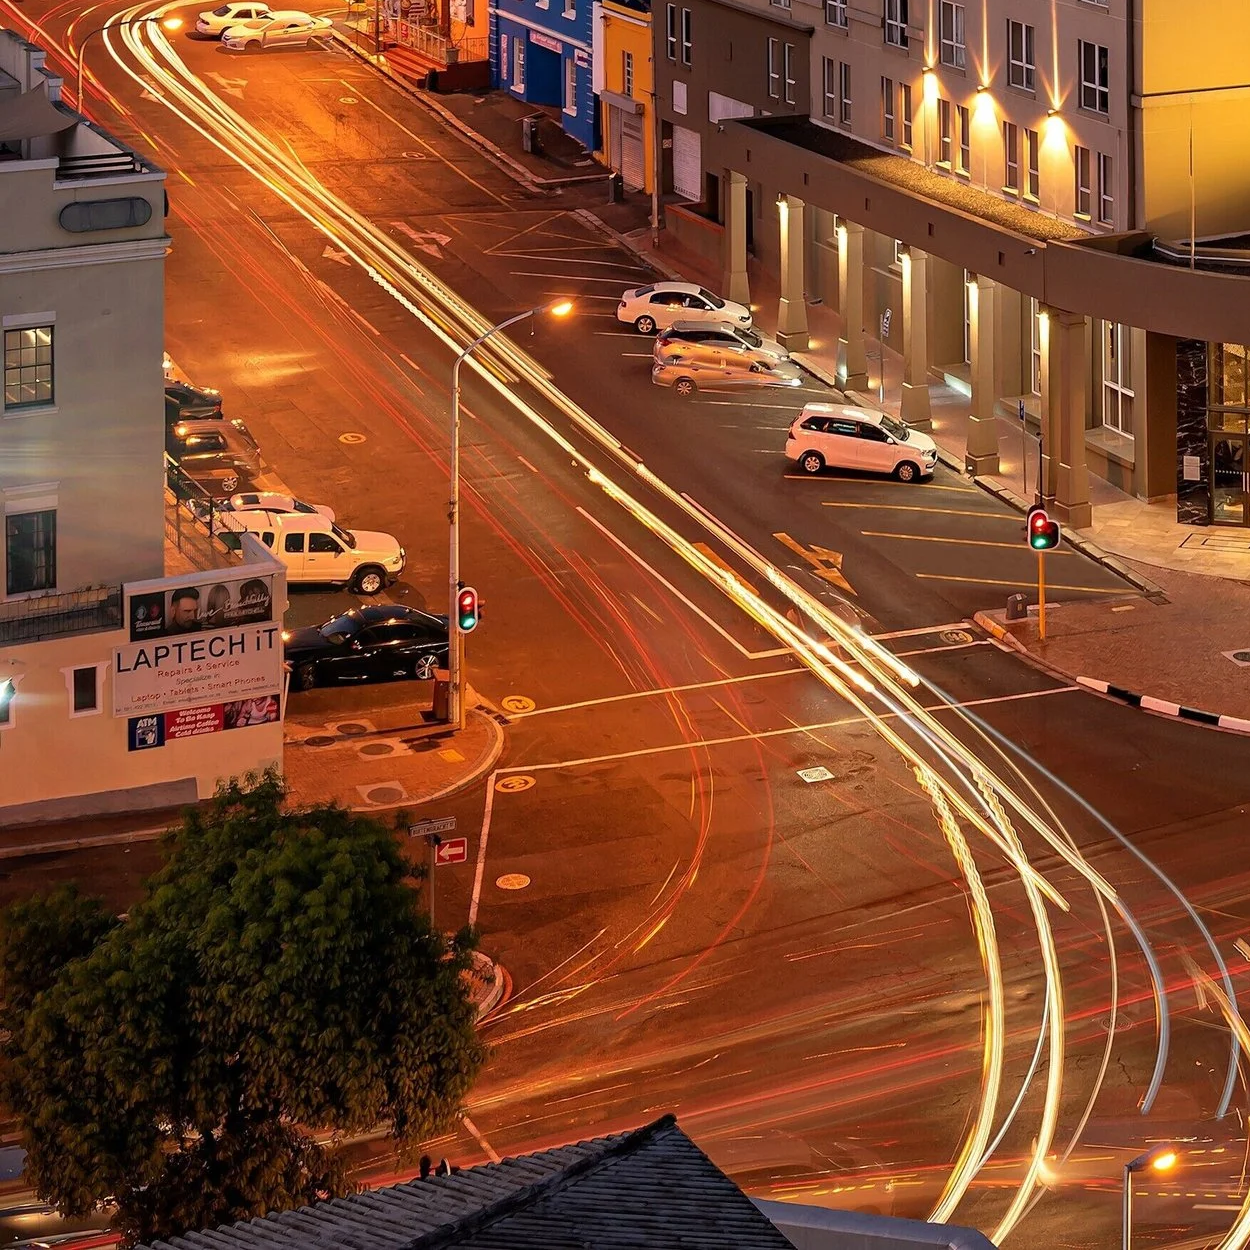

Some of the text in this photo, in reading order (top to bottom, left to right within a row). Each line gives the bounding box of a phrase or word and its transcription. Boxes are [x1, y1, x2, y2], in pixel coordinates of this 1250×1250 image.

[117, 633, 245, 673] LAPTECH
[157, 659, 240, 678] Repairs & Service
[131, 675, 266, 702] Laptop Tablets Smart Phones
[137, 717, 157, 729] ATM
